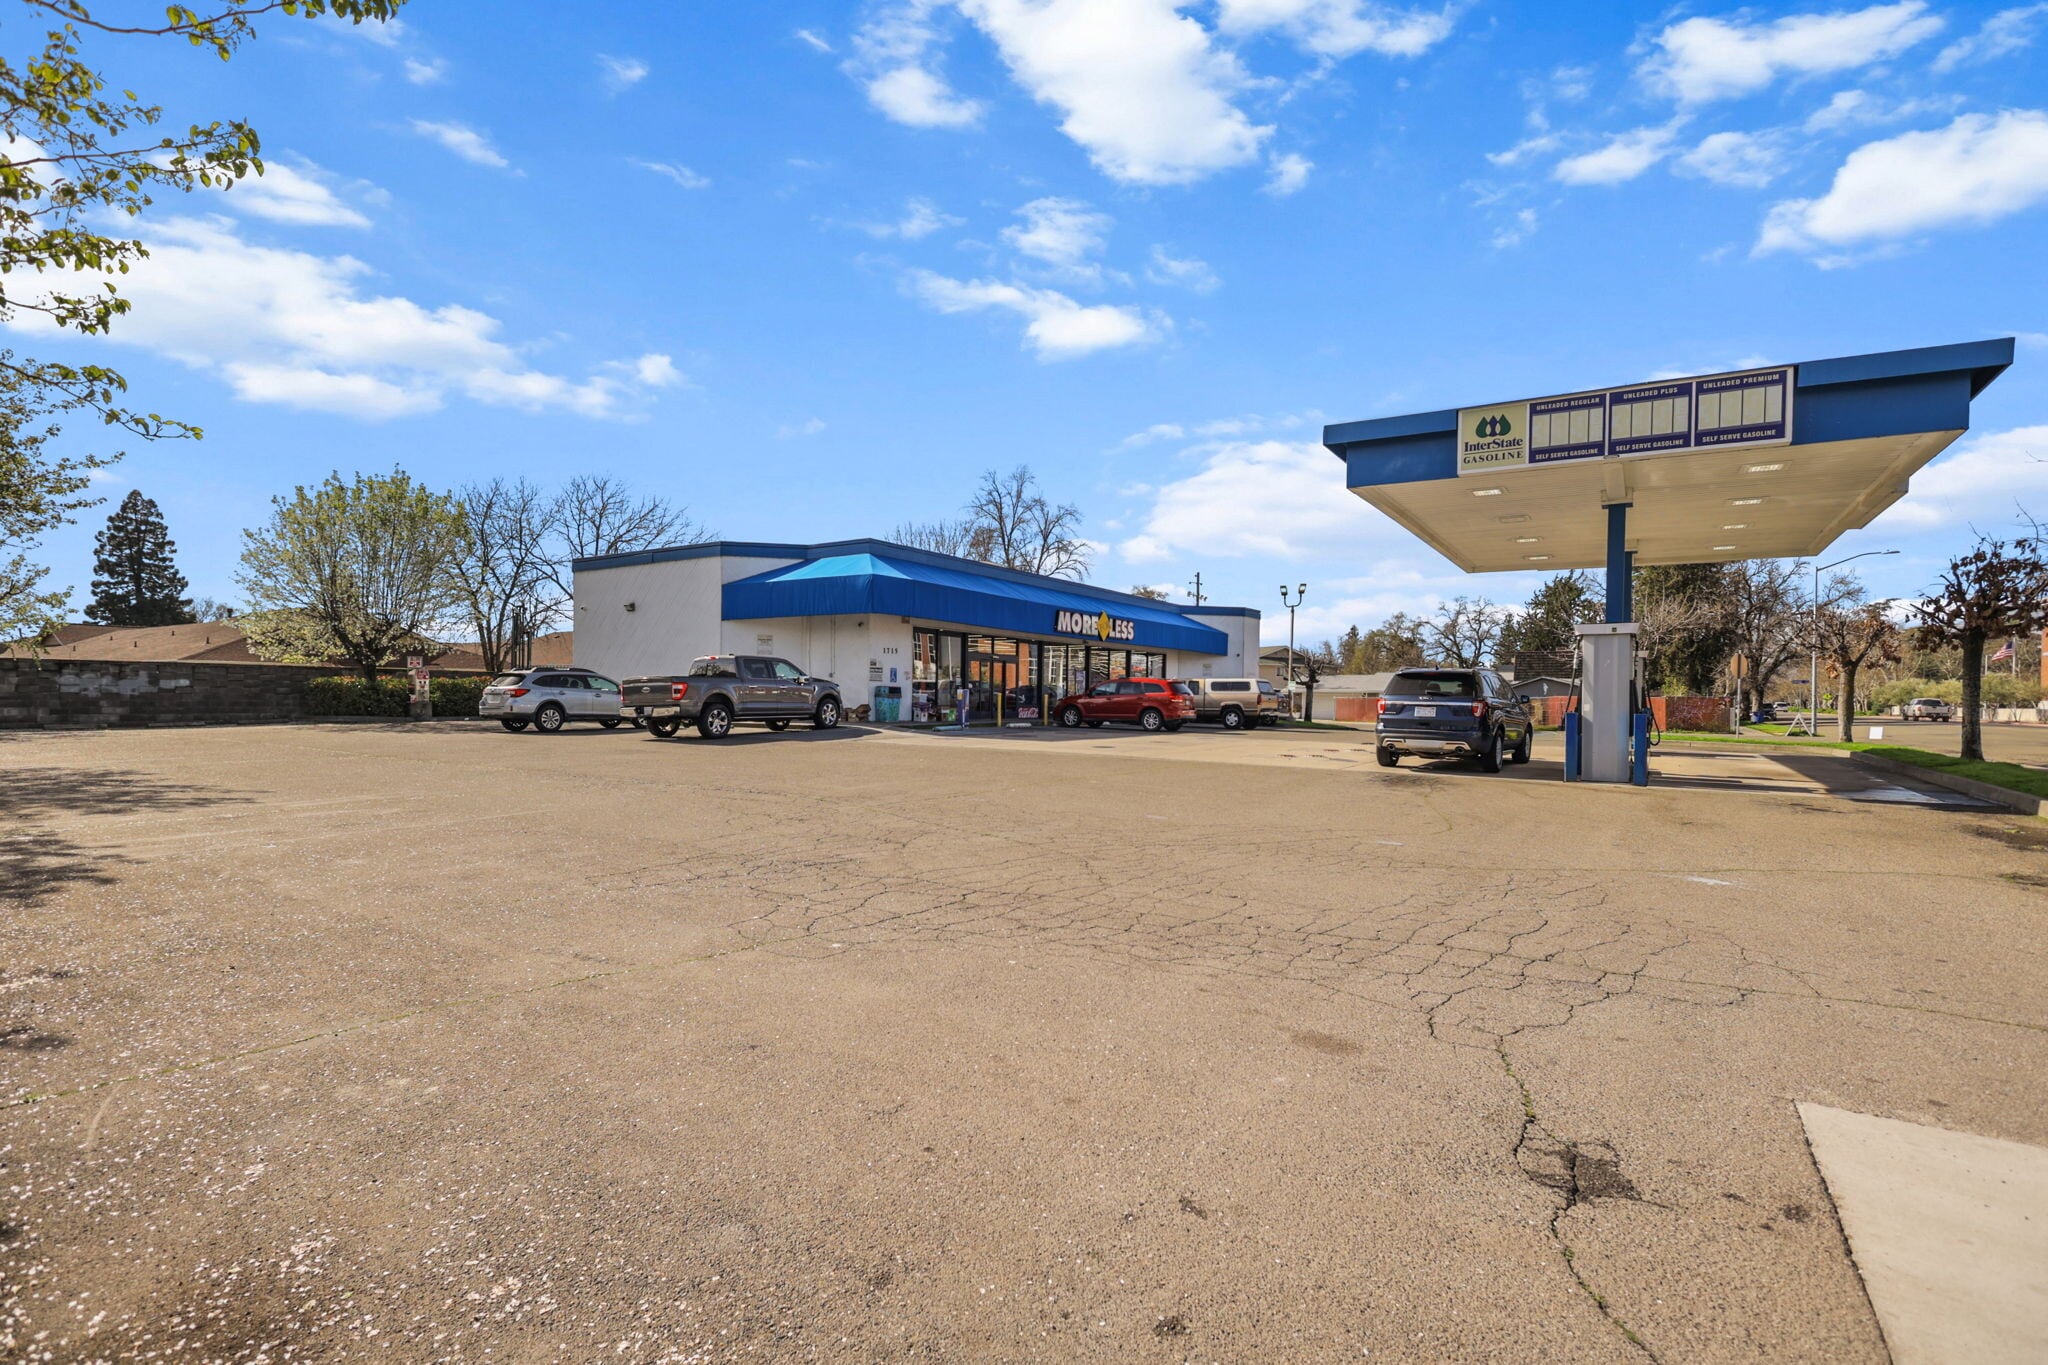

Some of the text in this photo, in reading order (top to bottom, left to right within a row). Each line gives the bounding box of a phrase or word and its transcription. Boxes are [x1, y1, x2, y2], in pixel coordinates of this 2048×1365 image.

[1703, 374, 1780, 389] UNLEADED PREMIUM
[1623, 386, 1678, 399] UNLEADED PLUS
[1536, 397, 1600, 411] UNLEADED REGULAR
[1702, 429, 1776, 443] SELF SERVE GASOLINE
[1464, 437, 1523, 453] InterState
[1615, 439, 1684, 452] SELF SERVE GASOLINE
[1463, 450, 1523, 465] GASOLINE
[1550, 451, 1569, 459] SERVE
[1569, 448, 1599, 457] GASOLINE
[1057, 610, 1134, 640] MORE LESS
